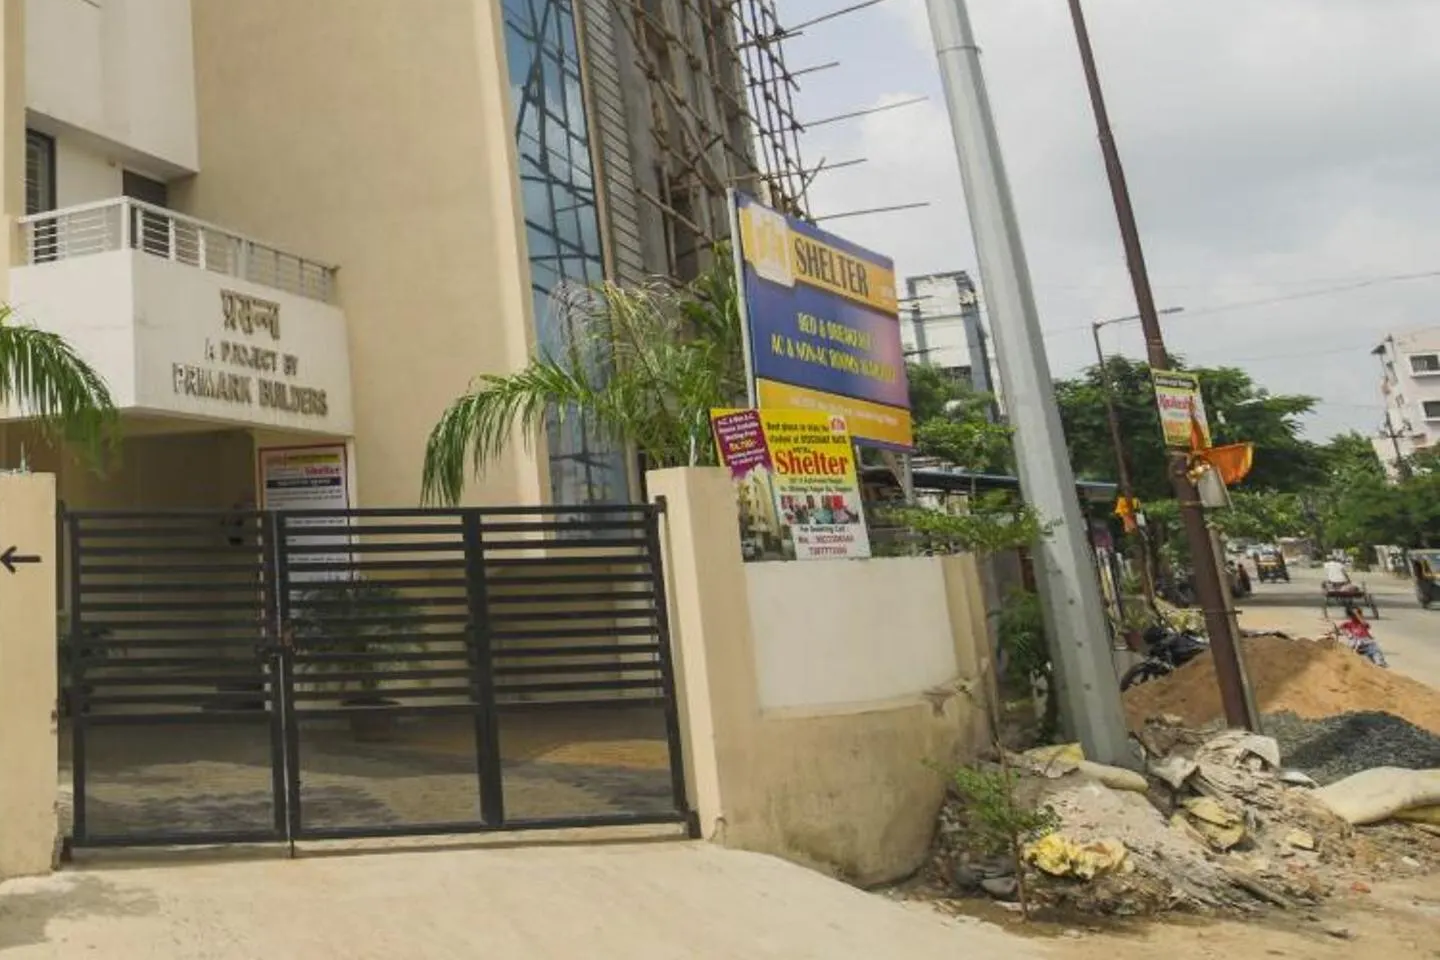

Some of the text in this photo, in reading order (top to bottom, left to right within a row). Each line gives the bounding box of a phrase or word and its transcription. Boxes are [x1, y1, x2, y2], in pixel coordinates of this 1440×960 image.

[794, 237, 869, 299] SHELTER
[220, 340, 279, 373] PROJECT
[282, 353, 299, 376] BY
[258, 379, 328, 417] BUILDERS
[775, 449, 849, 475] Shelter
